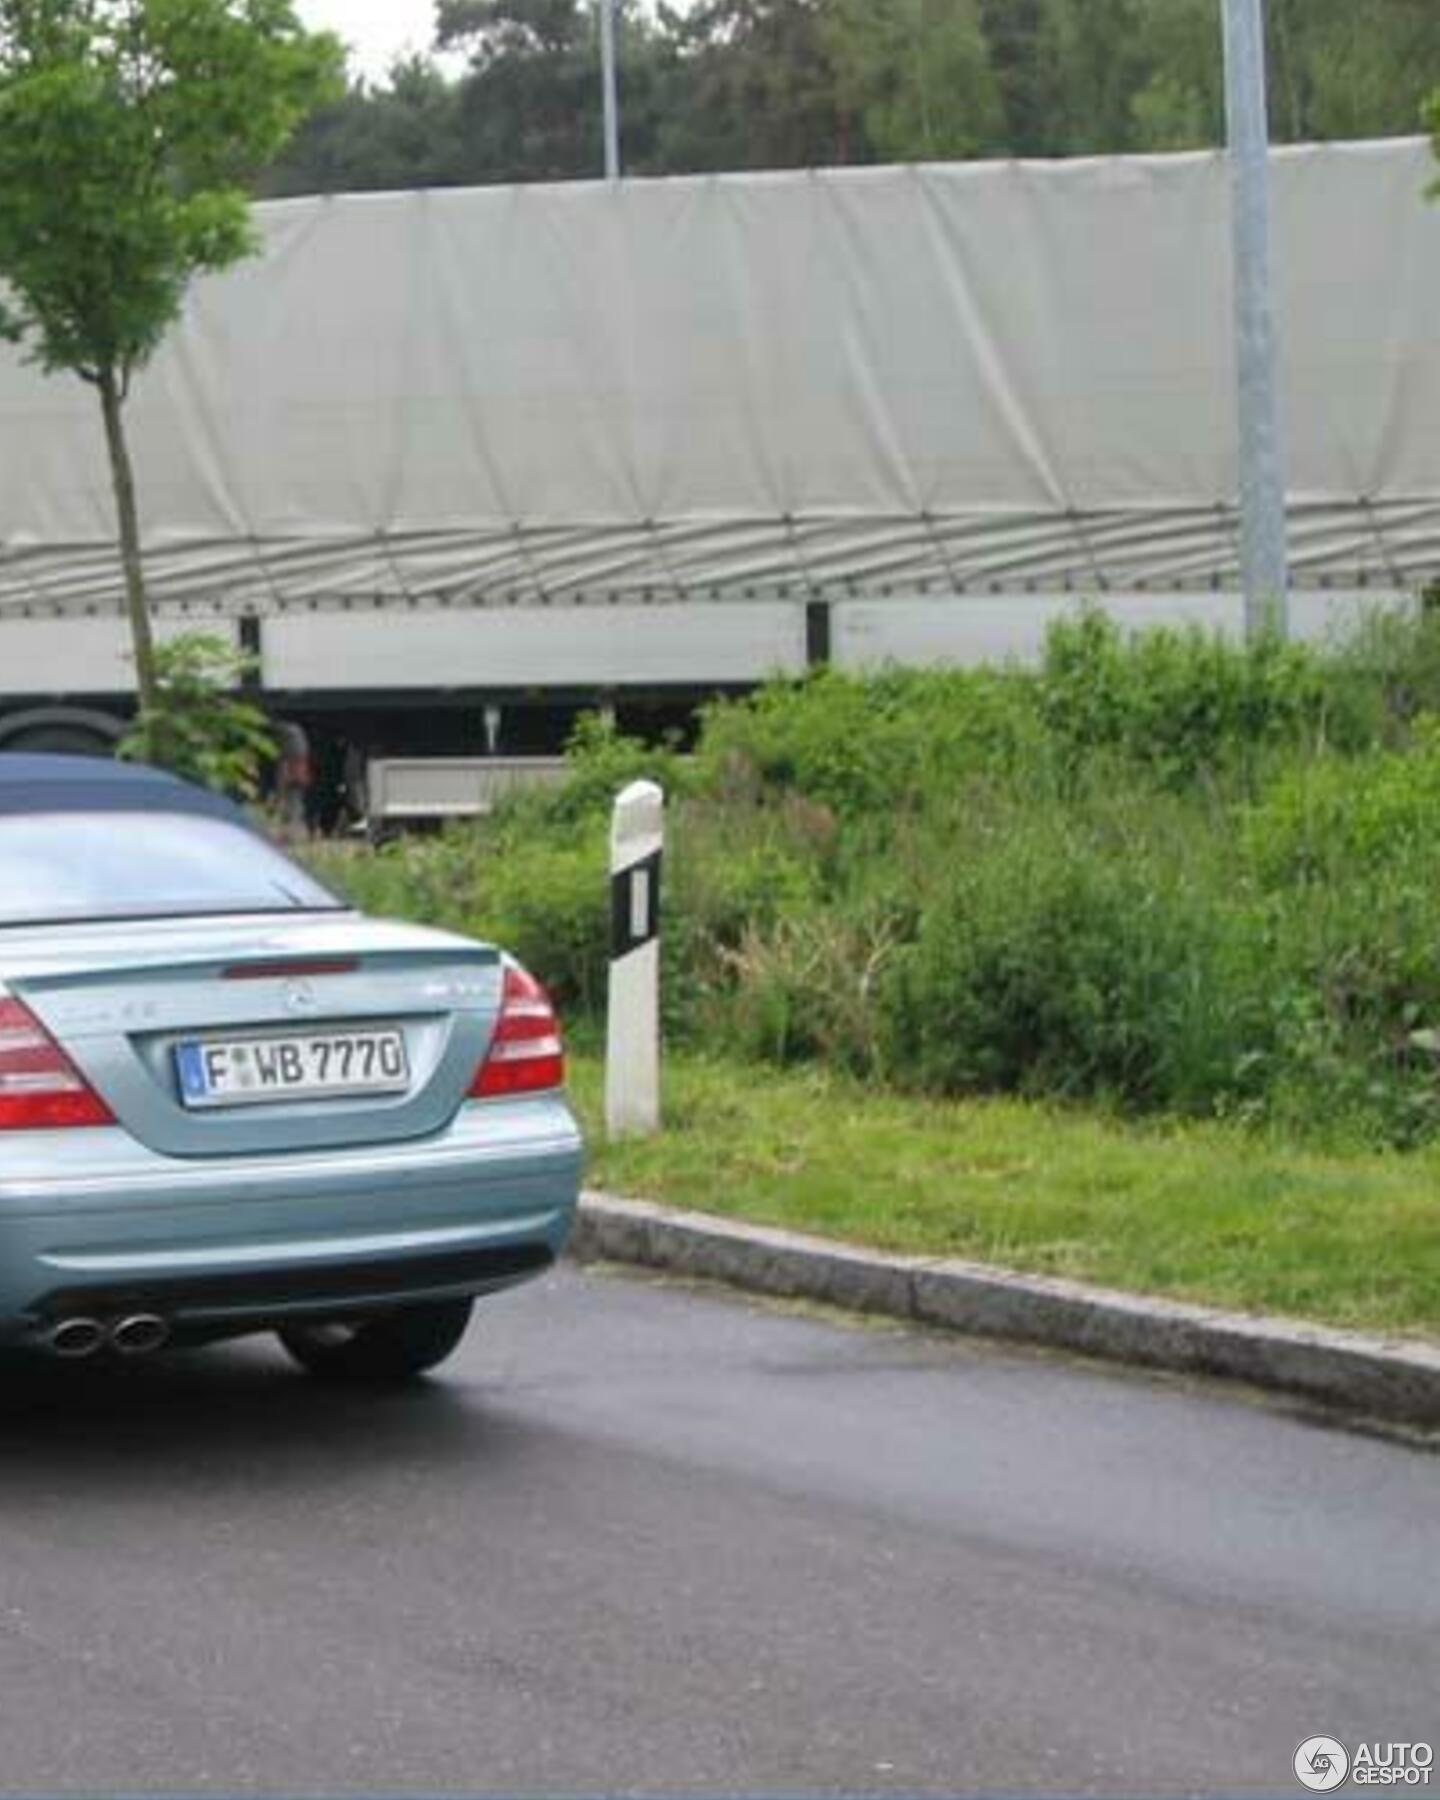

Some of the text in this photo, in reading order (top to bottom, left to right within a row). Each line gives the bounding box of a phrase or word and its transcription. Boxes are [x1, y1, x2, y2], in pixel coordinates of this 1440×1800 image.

[205, 1049, 227, 1088] F
[254, 1043, 304, 1085] WB
[311, 1038, 402, 1081] 7770
